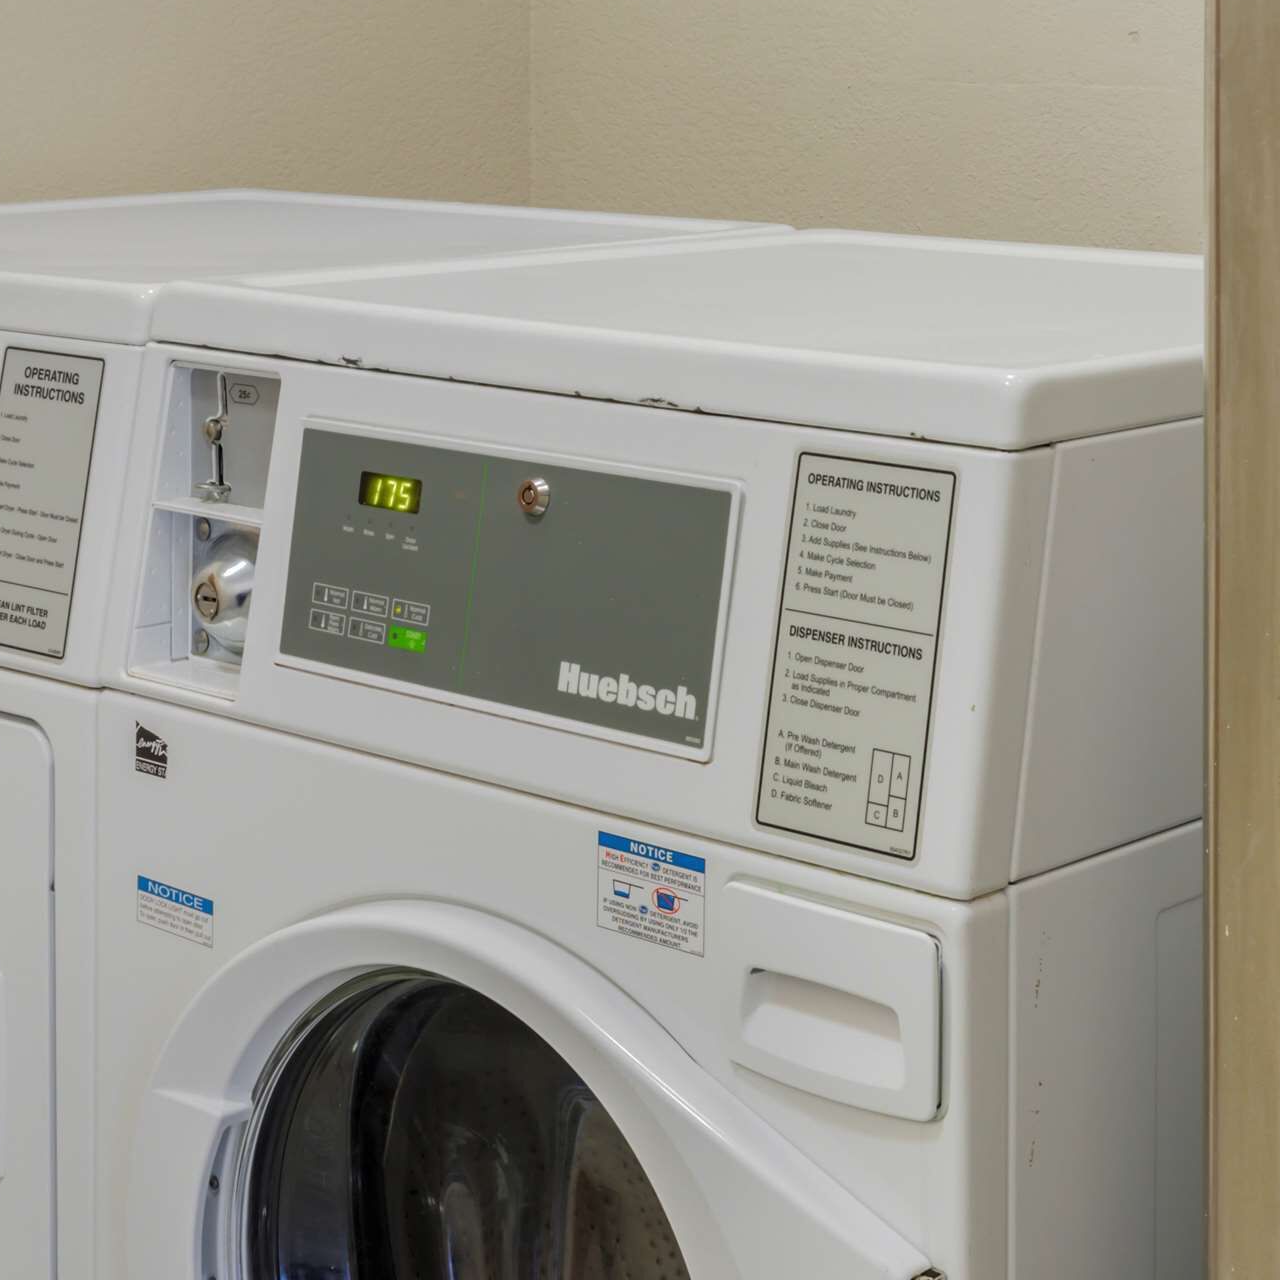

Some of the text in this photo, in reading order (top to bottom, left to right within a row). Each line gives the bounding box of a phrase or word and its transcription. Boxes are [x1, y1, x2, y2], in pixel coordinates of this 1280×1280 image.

[24, 366, 80, 385] OPERATING
[14, 383, 85, 405] INSTRUCTIONS
[373, 479, 412, 510] 175
[808, 472, 941, 502] OPERATING INSTRUCTIONS
[812, 504, 830, 514] Load
[830, 506, 856, 520] Laundry
[810, 519, 829, 530] Close
[831, 522, 846, 532] Door
[808, 535, 821, 545] Add
[823, 536, 850, 550] Supplies
[852, 542, 867, 553] (See
[869, 544, 907, 559] Instructions
[907, 551, 931, 564] Below)
[806, 551, 824, 562] Make
[826, 554, 844, 566] Cycle
[846, 557, 876, 570] Selection
[805, 568, 822, 578] Make
[824, 570, 853, 583] Payment
[803, 583, 821, 594] Press
[823, 586, 838, 597] Start
[839, 589, 858, 601] (Door
[860, 592, 876, 604] Must
[877, 595, 886, 605] be
[887, 597, 914, 612] Closed)
[11, 602, 26, 612] LINT
[26, 606, 49, 618] FILTER
[9, 614, 27, 625] EACH
[28, 619, 47, 630] LOAD
[789, 625, 923, 661] DISPENSER INSTRUCTIONS
[794, 652, 812, 663] Open
[814, 655, 847, 671] Dispenser
[848, 662, 864, 673] Door
[557, 661, 696, 720] Huebsch
[792, 670, 809, 682] Load
[810, 673, 837, 688] Supplies
[840, 679, 845, 688] in
[847, 681, 869, 694] Proper
[871, 685, 916, 703] Compartment
[790, 695, 808, 707] Close
[810, 699, 842, 714] Dispenser
[844, 705, 860, 717] Door
[787, 731, 799, 741] Pre
[801, 734, 820, 746] Wash
[821, 738, 856, 754] Detergent
[794, 744, 822, 759] Offered)
[784, 758, 800, 769] Main
[802, 763, 821, 774] Wash
[822, 766, 857, 783] Detergent
[877, 774, 884, 783] D
[896, 772, 903, 781] A
[782, 775, 803, 788] Liquid
[804, 779, 828, 793] Bleach
[780, 791, 801, 804] Fabric
[803, 795, 832, 810] Softener
[873, 810, 880, 819] C
[893, 808, 899, 818] B
[630, 841, 673, 862] NOTICE
[601, 860, 639, 876] RECOMMENDED
[650, 872, 663, 882] BEST
[664, 876, 702, 893] PERFORMANCE
[662, 867, 693, 881] DETERGENT
[148, 881, 203, 910] NOTICE
